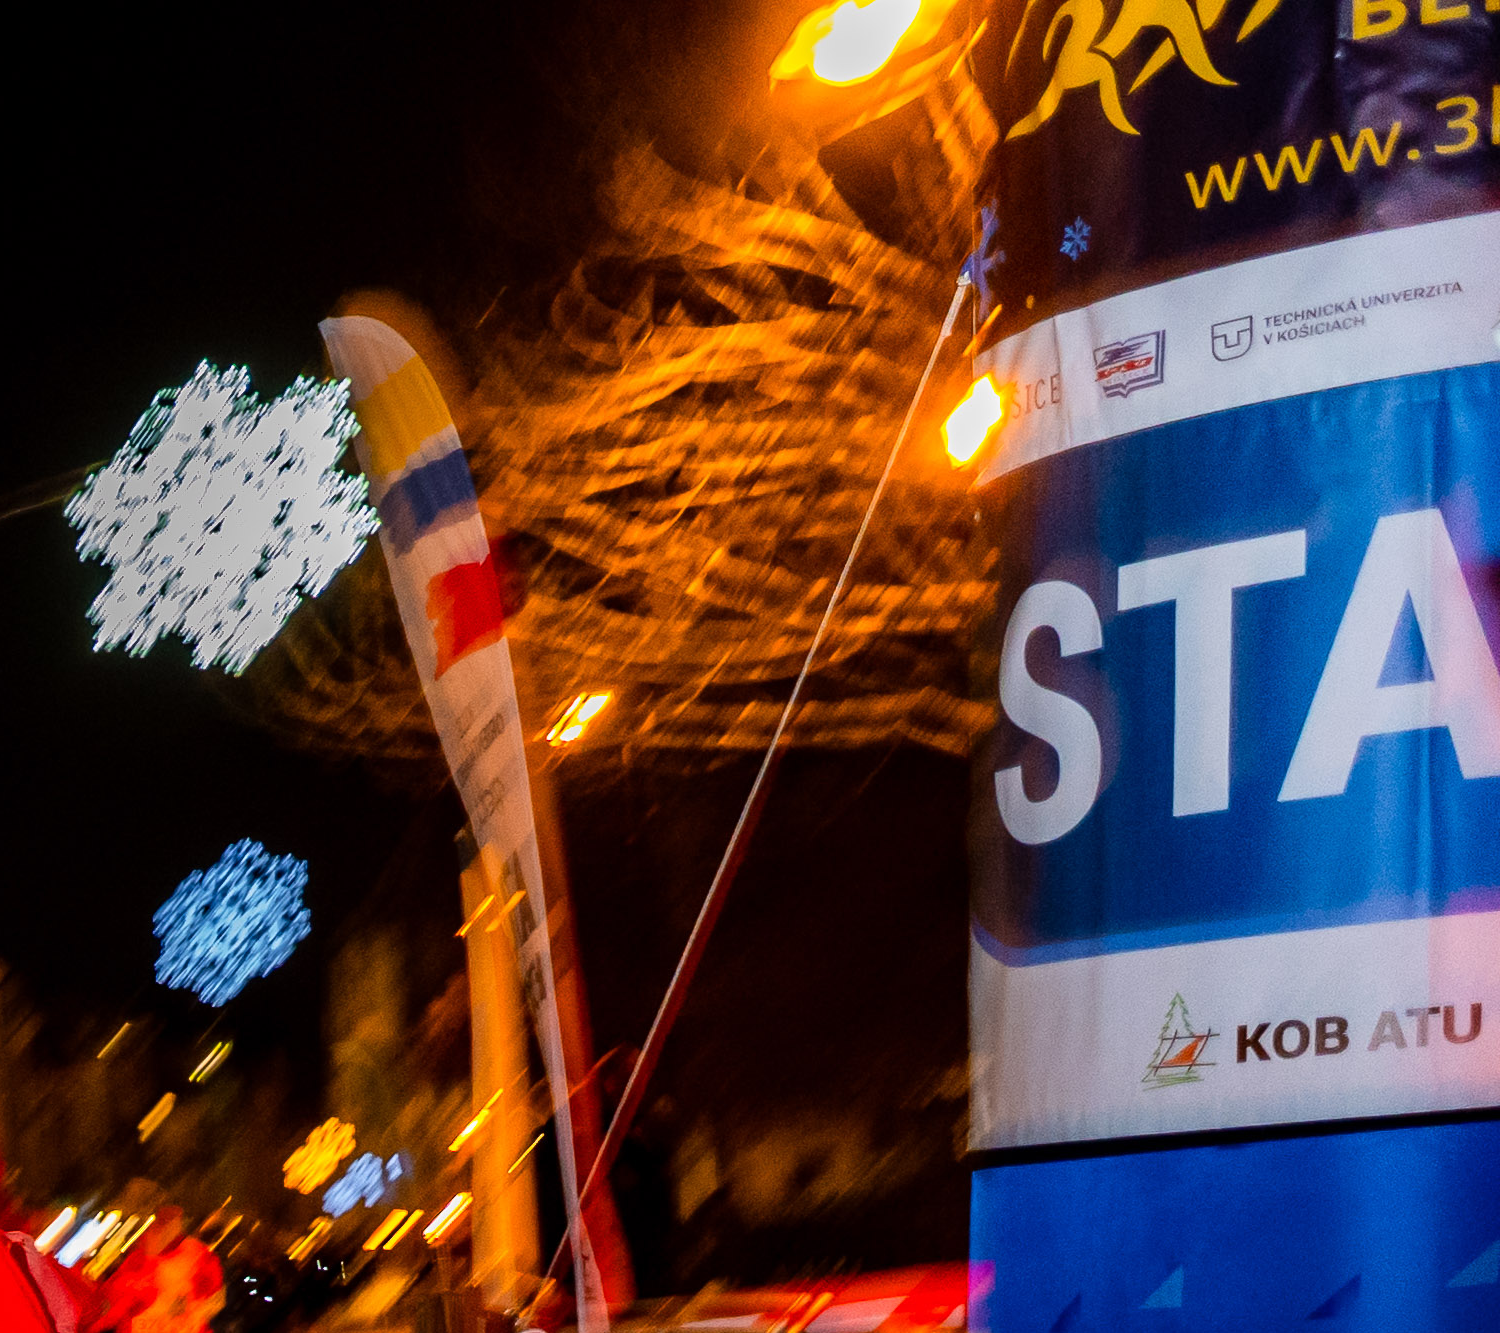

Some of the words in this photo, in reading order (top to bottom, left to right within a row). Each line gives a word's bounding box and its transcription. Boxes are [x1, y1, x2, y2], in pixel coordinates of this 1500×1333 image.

[1264, 299, 1357, 328] TECHNICKÁ
[1361, 282, 1463, 310] UNIVERZITA
[1263, 333, 1273, 345] V
[1277, 315, 1366, 342] KOŠICIACH
[1236, 1016, 1349, 1064] KOB
[1367, 1003, 1483, 1052] ATU
